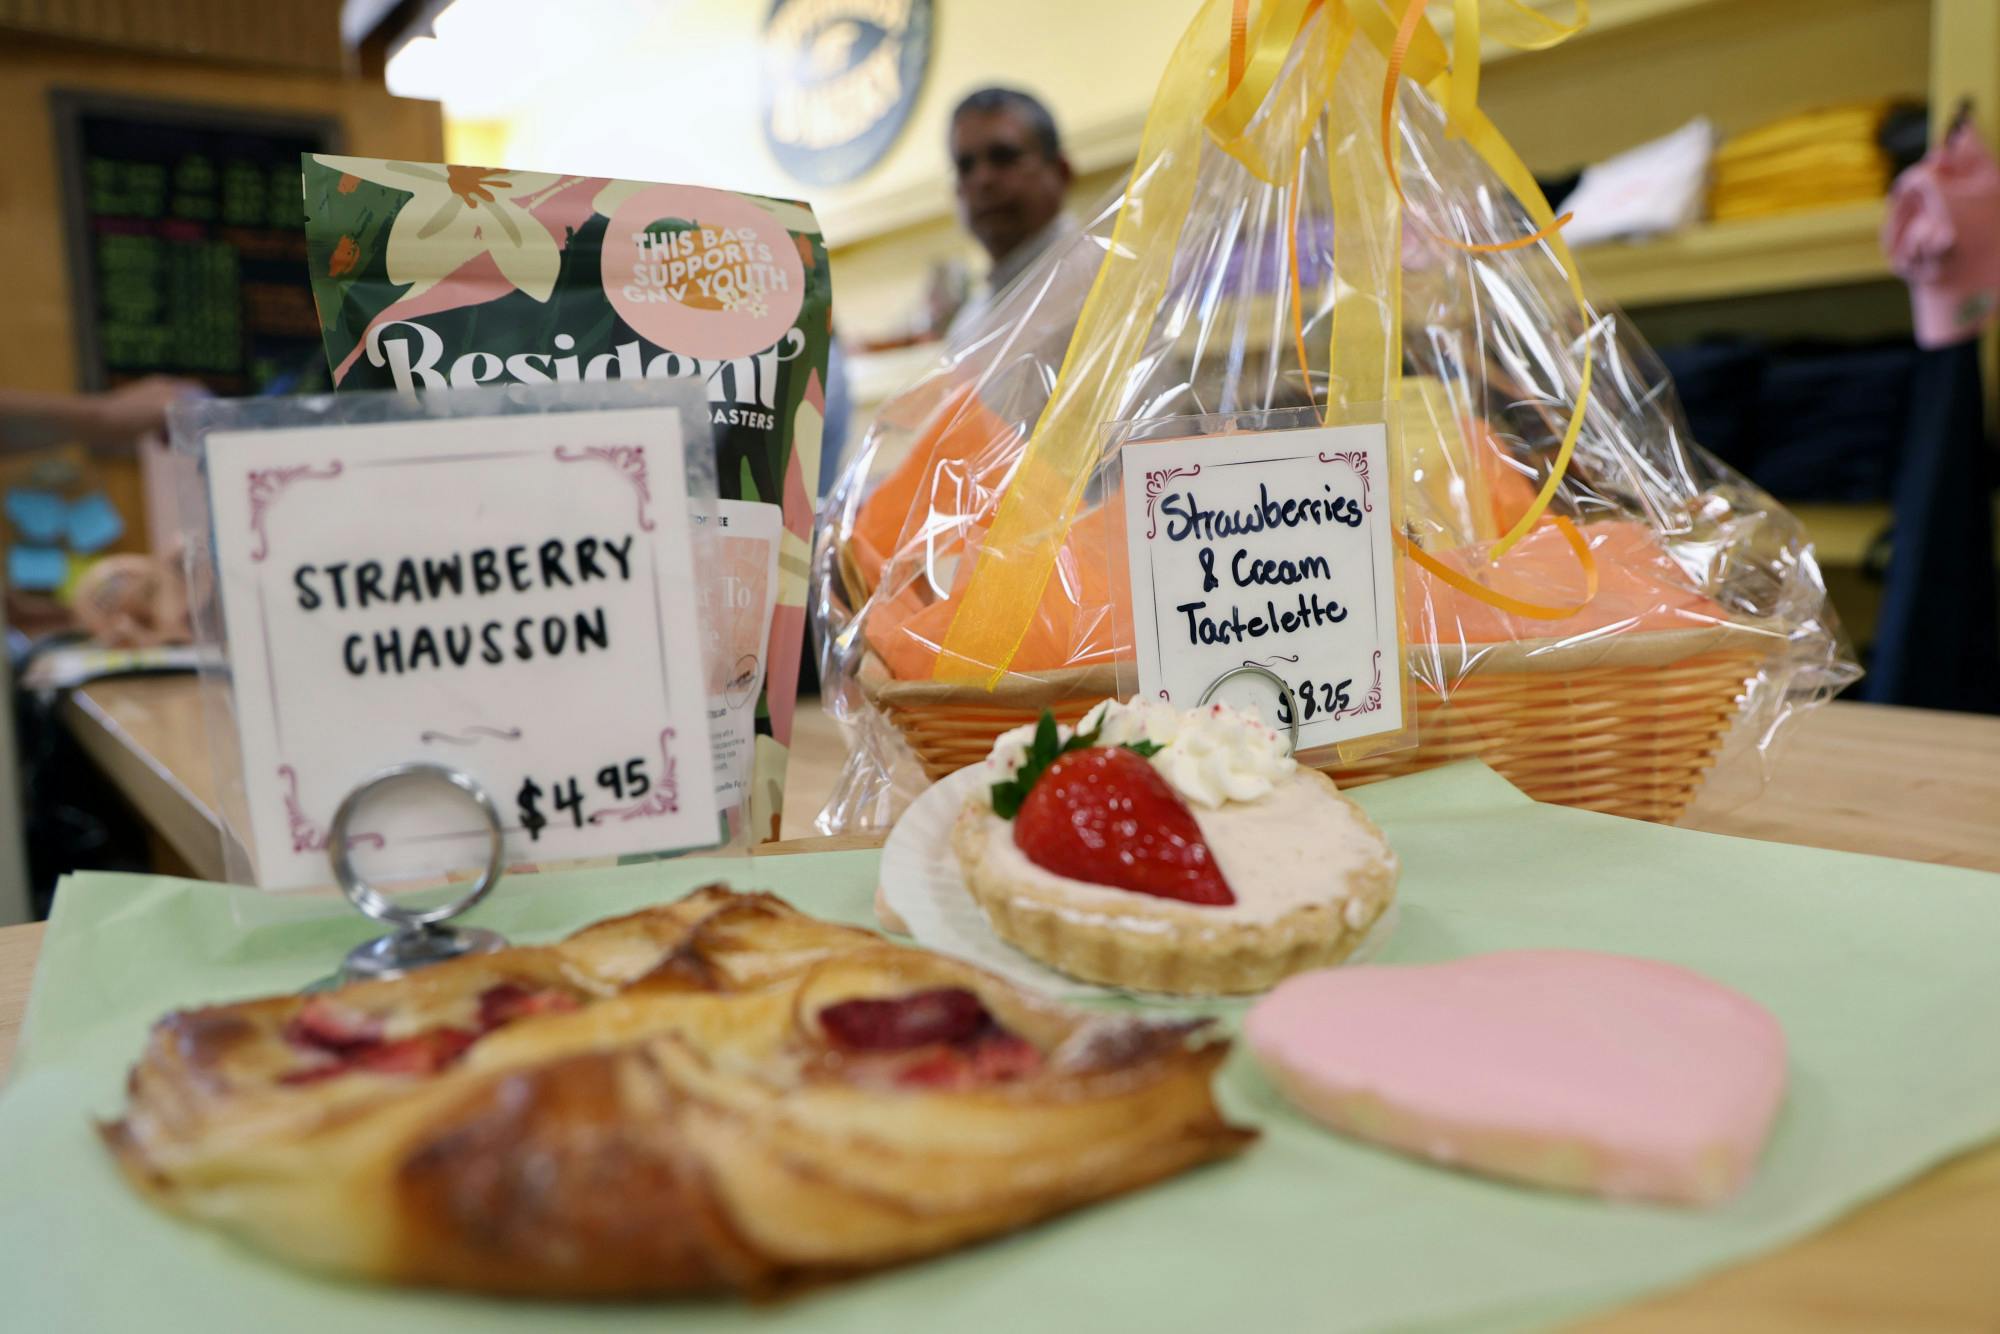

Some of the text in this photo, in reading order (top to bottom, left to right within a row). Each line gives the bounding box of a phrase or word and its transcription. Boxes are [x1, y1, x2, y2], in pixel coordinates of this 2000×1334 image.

[632, 227, 758, 261] THIS BAG
[633, 240, 773, 288] SUPPORTS
[622, 263, 789, 304] GNV YOUTH
[365, 320, 806, 410] Resident
[707, 408, 775, 431] ASTERS
[1160, 483, 1363, 541] Strawberries
[293, 534, 635, 611] STRAWBERRY
[1198, 547, 1332, 593] & Cream
[342, 607, 610, 676] CHAUSSON
[1176, 593, 1348, 646] Tartelette
[1277, 679, 1353, 724] $8.25
[516, 758, 651, 841] $4.95
